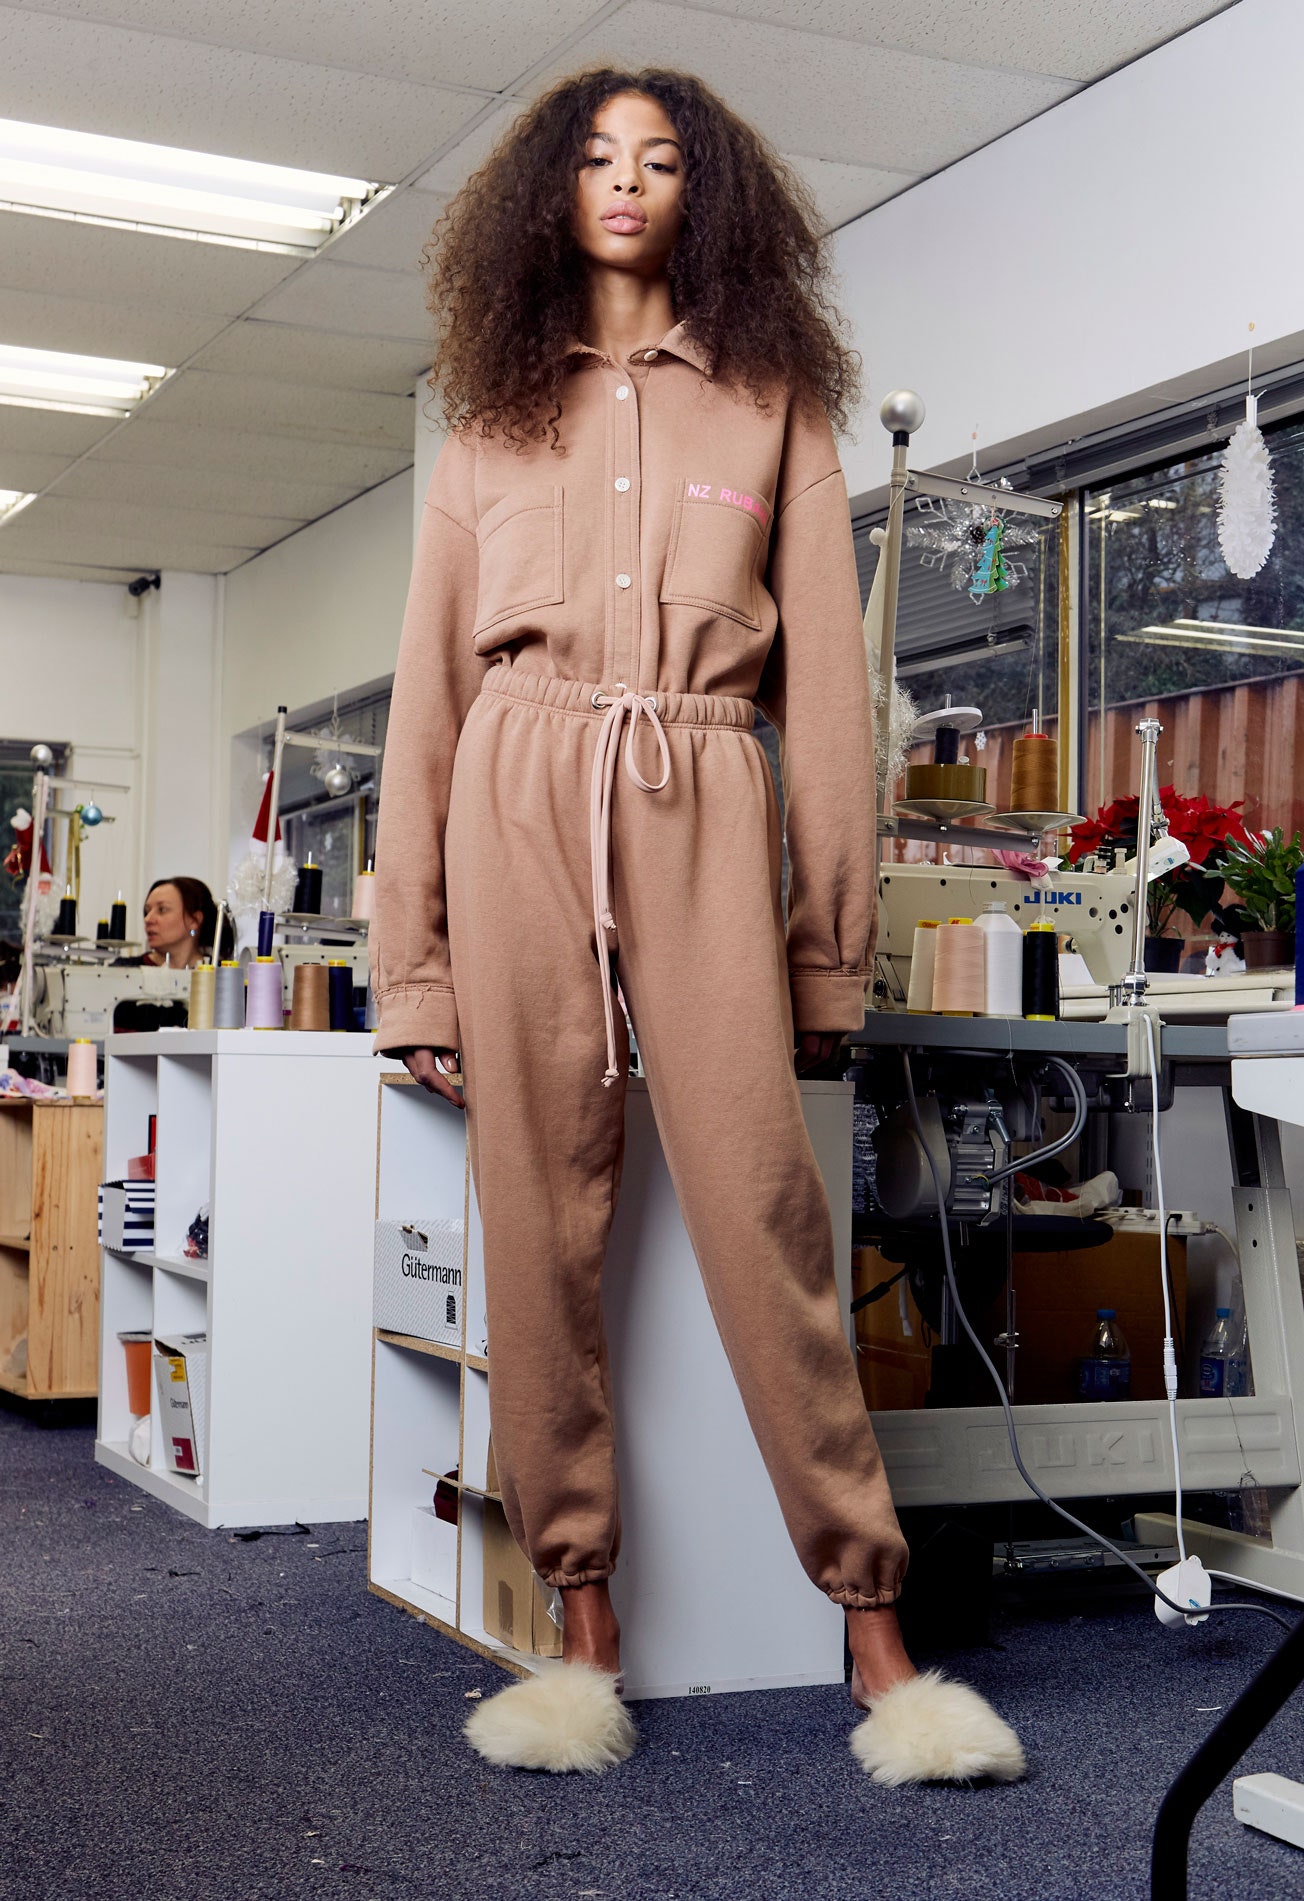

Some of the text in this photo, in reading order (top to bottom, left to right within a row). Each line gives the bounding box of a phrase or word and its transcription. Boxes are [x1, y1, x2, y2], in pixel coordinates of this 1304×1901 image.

[687, 483, 712, 499] NZ
[1023, 890, 1082, 905] JUKI
[401, 1253, 462, 1287] Gütermann
[688, 1685, 711, 1695] 140820
